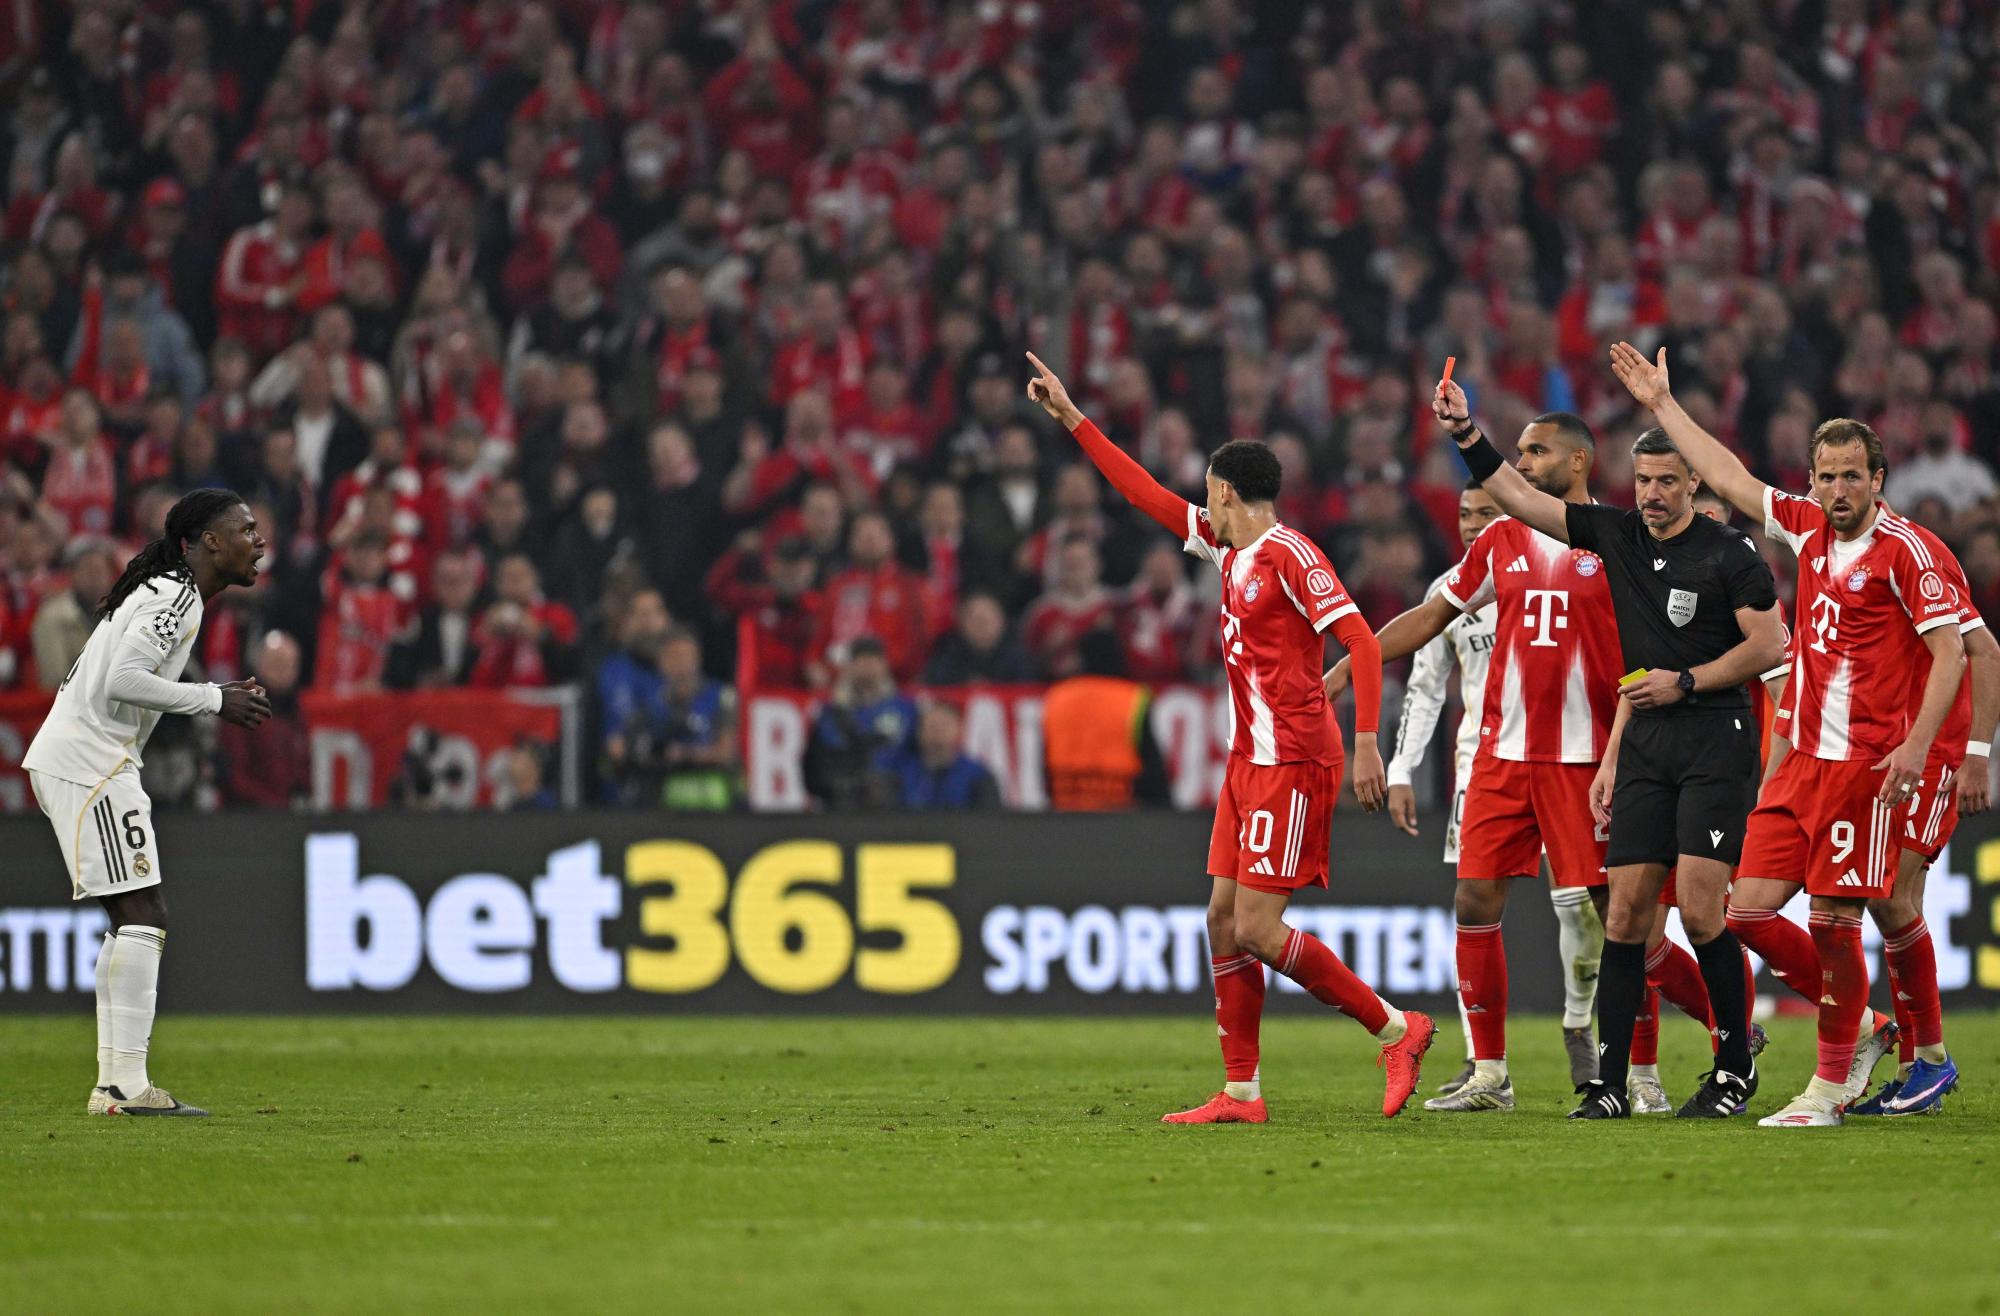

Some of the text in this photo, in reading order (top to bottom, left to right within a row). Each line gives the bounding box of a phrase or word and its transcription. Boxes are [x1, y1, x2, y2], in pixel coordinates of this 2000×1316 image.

[1316, 593, 1346, 612] Allianz
[1670, 609, 1691, 617] OFFICIAL
[1924, 601, 1952, 615] Allianz
[122, 809, 146, 850] 6
[1830, 820, 1855, 864] 9
[305, 832, 962, 994] bet365
